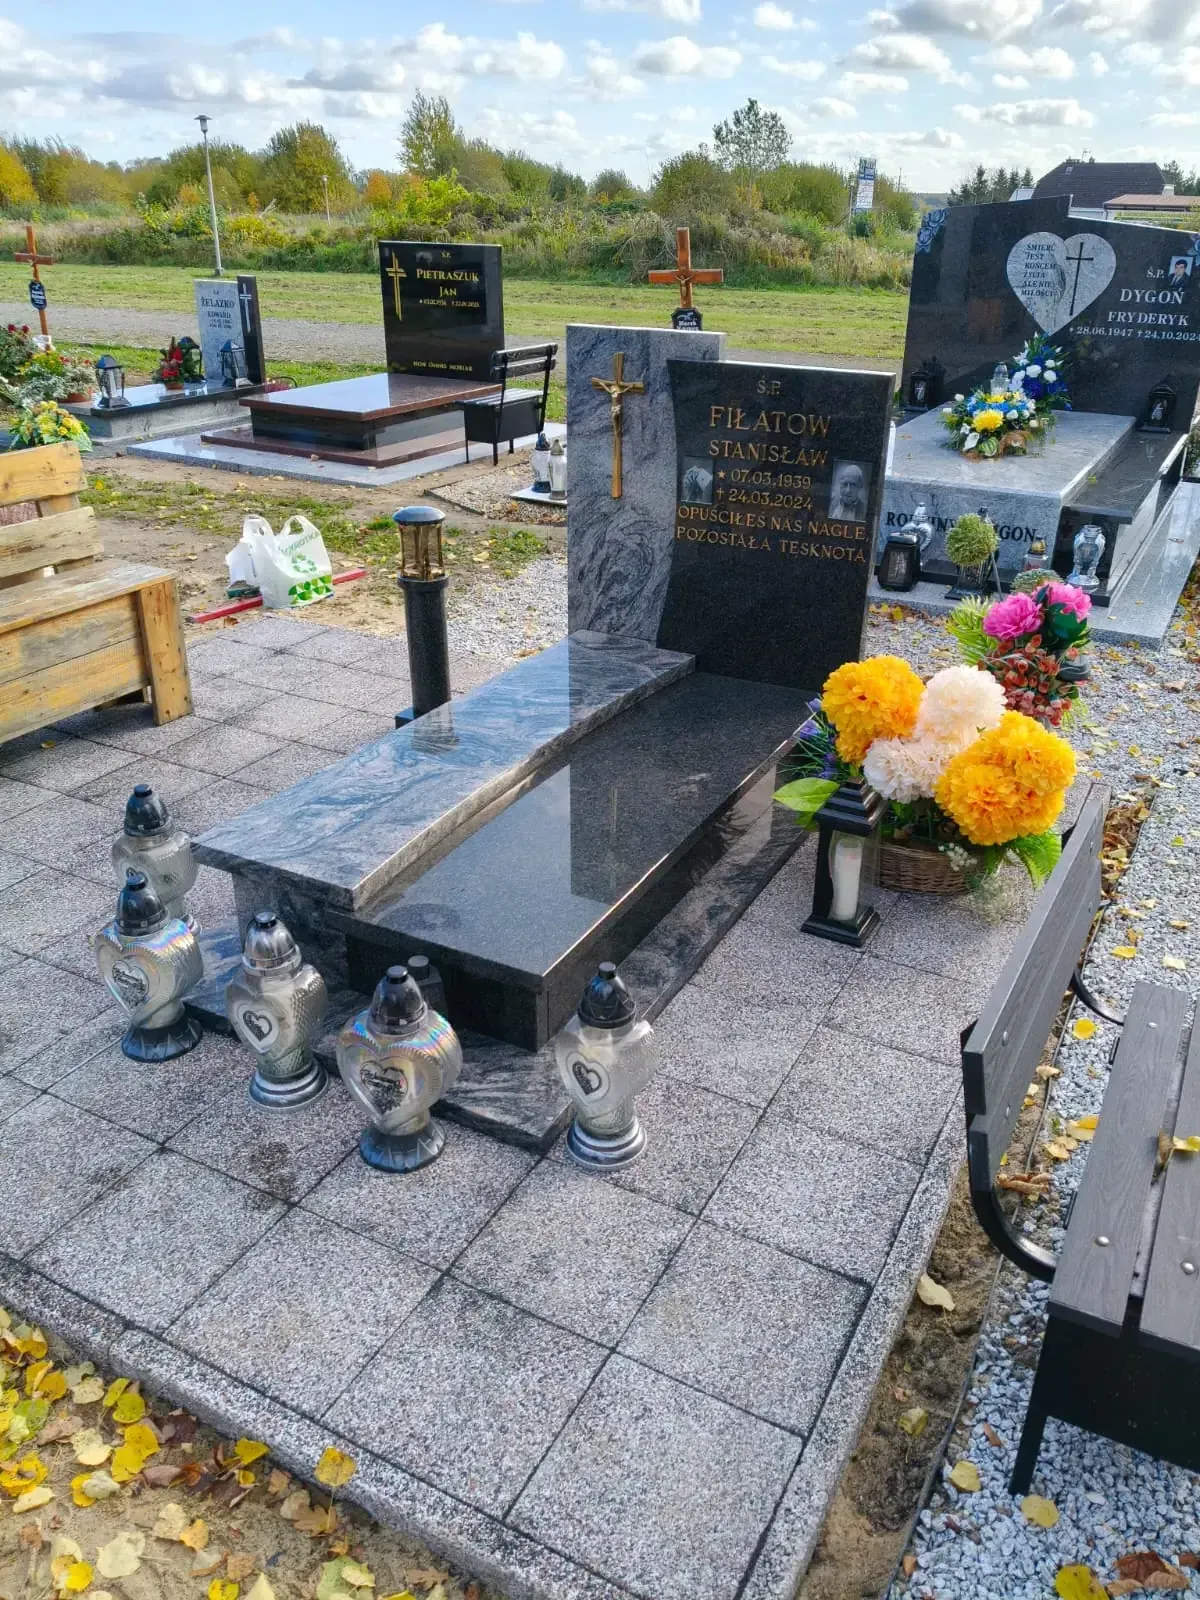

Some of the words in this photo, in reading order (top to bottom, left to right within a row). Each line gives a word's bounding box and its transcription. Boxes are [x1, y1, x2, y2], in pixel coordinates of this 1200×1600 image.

[1024, 252, 1044, 260] JEST
[416, 268, 479, 282] PIETRASZUK
[439, 286, 457, 298] JAN
[1119, 287, 1185, 305] DYGOŃ
[1107, 311, 1189, 327] FRYDERYK
[1076, 326, 1134, 337] 28.06.1947
[709, 405, 831, 438] FIŁATOW
[708, 439, 828, 467] STANISŁAW
[730, 468, 812, 490] 07.03.1939
[728, 488, 813, 512] 24.03.2024
[770, 517, 802, 533] NAS
[676, 526, 772, 551] POZOSTAŁA
